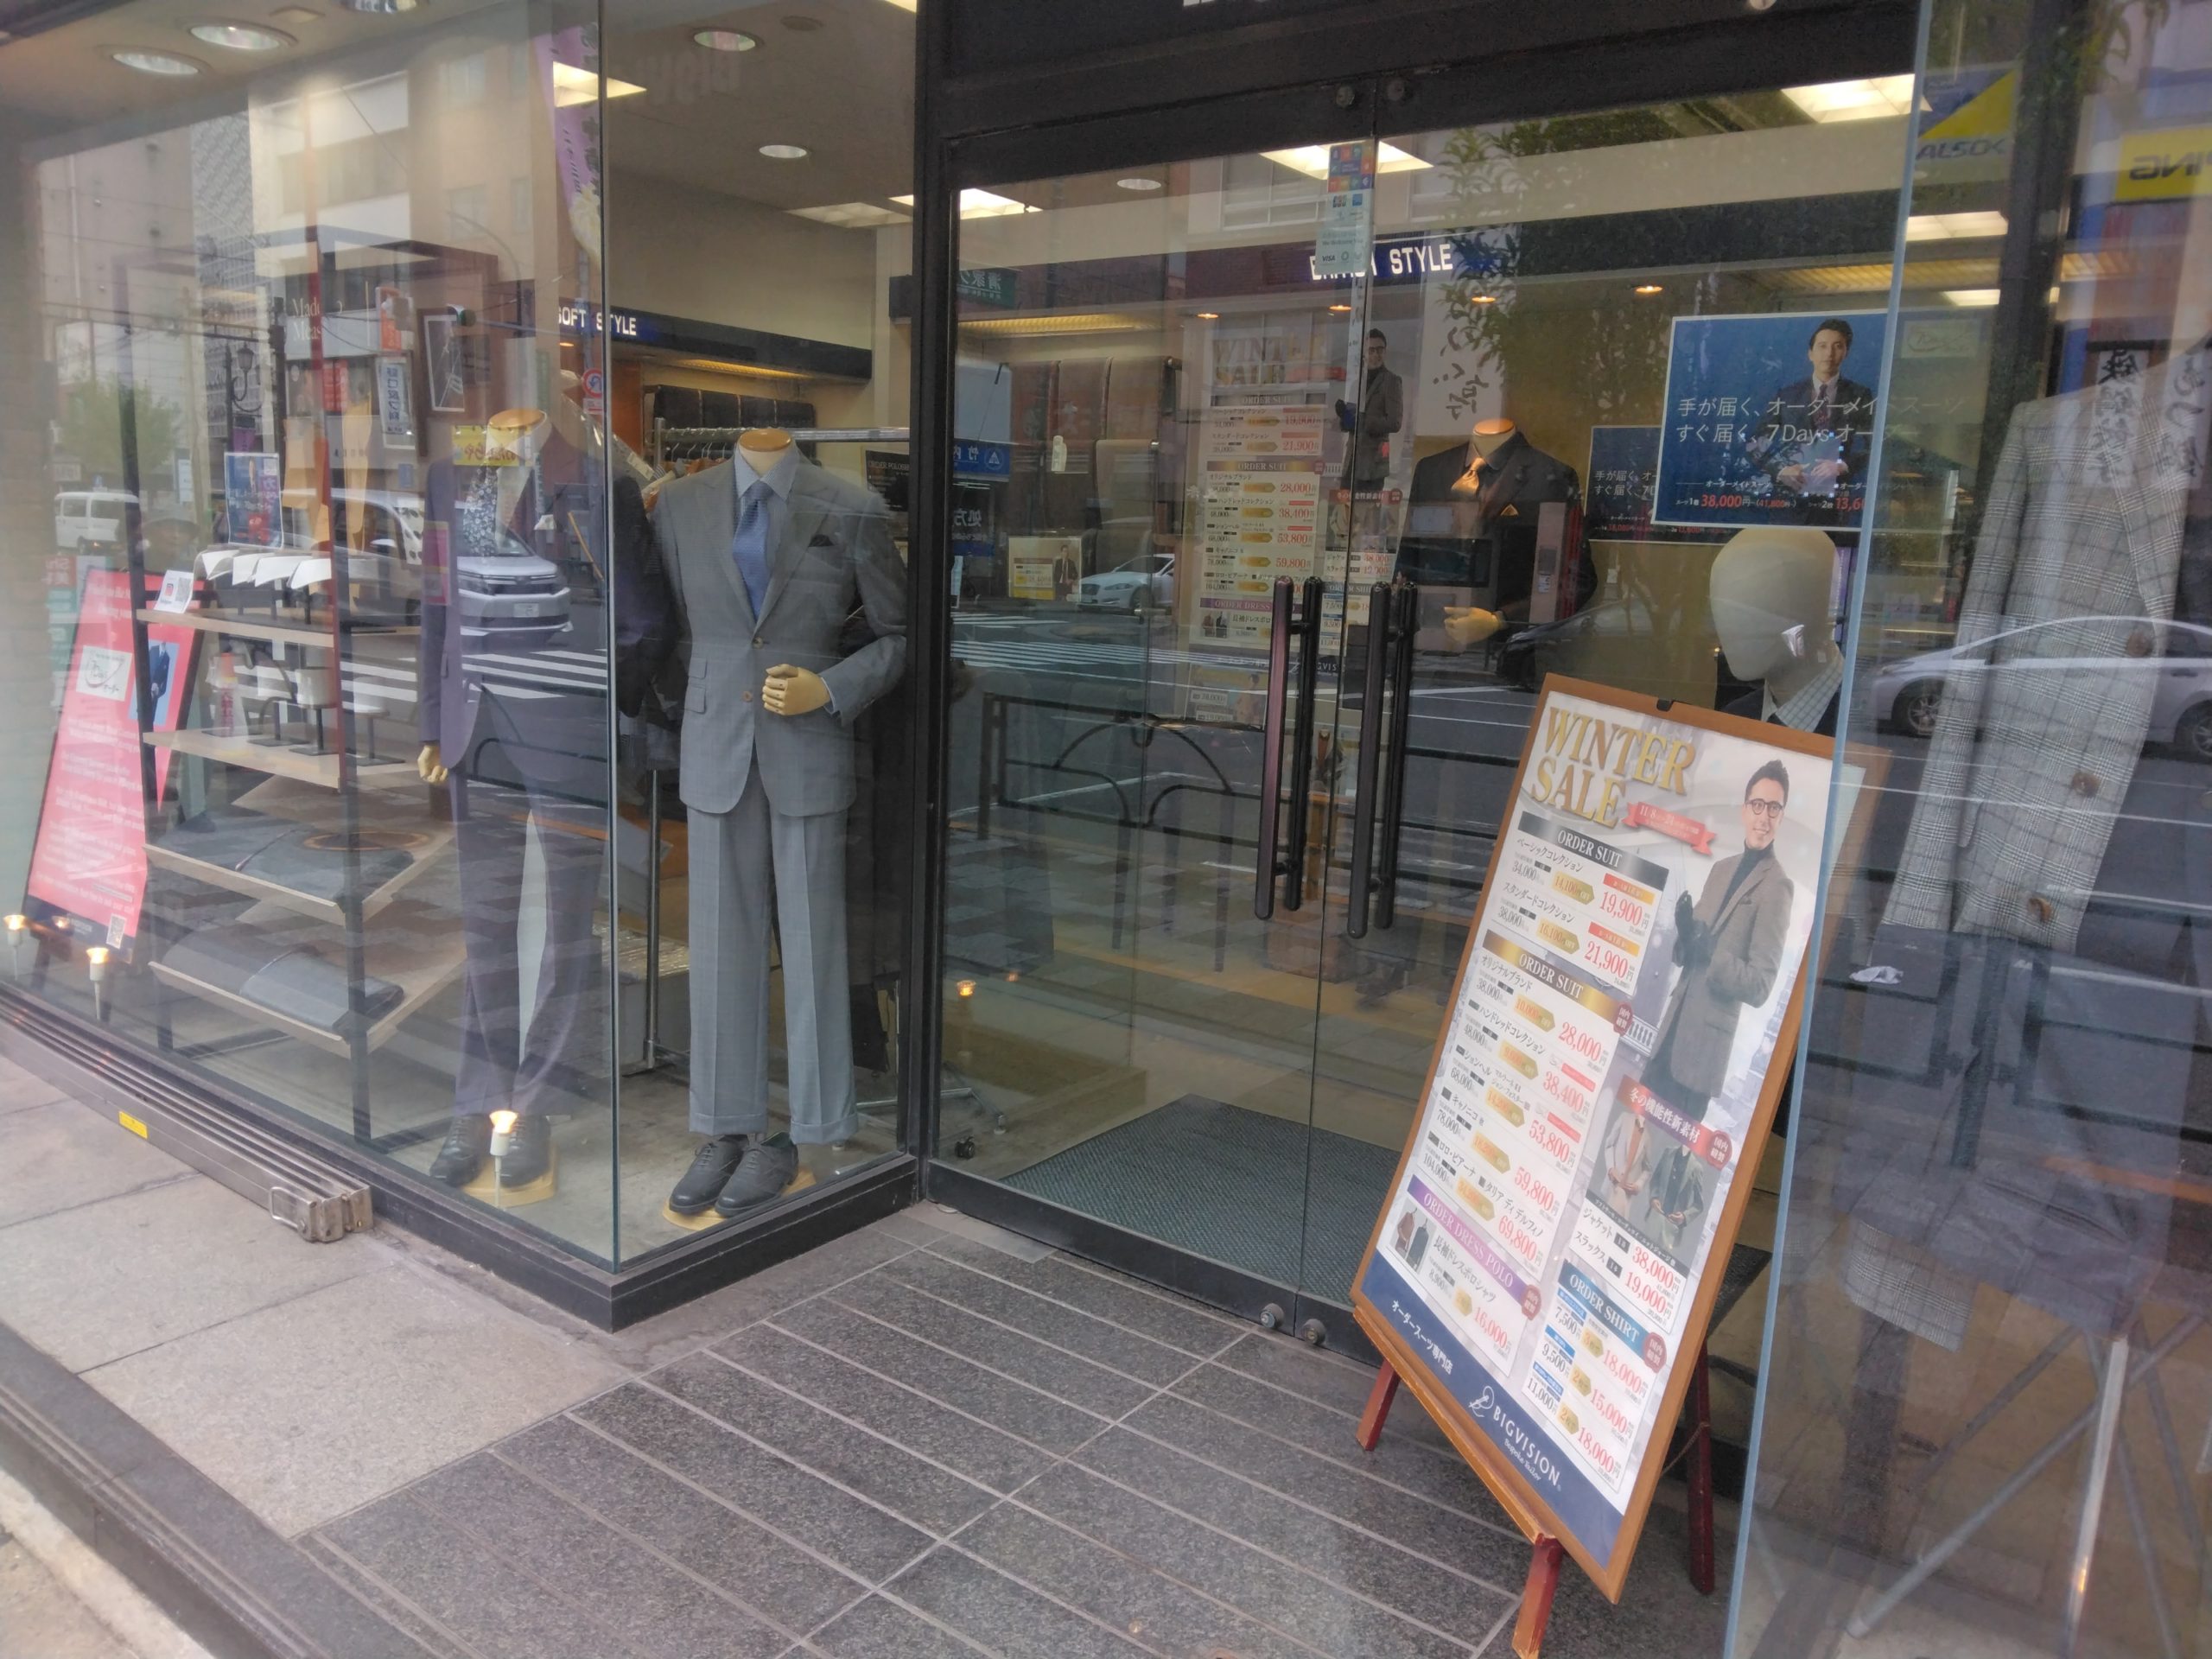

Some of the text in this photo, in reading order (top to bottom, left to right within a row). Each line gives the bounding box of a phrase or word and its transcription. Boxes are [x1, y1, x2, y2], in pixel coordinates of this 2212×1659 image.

[1916, 138, 2005, 161] ALSOK
[1389, 244, 1453, 275] STYLE
[1238, 462, 1268, 471] ORDER
[1215, 600, 1243, 608] ORDER
[1553, 706, 1705, 796] WINTER
[1540, 755, 1626, 830] SALE
[1515, 837, 1584, 874] ベーシックコレクション
[1556, 830, 1622, 868] ORDER SUIT
[1502, 881, 1575, 925] スタンダードコレクション
[1479, 954, 1533, 993] オリジナルブランド
[1517, 952, 1583, 1000] ORDER SUIT
[1477, 1005, 1547, 1057] ハンドレッドコレクション
[1630, 1087, 1700, 1143] 冬の機能性新素材
[1437, 1140, 1477, 1180] ロロ・ピアーナ
[1422, 1192, 1514, 1289] ORDER DRESS POLO
[1581, 1206, 1613, 1241] ジャケット
[1574, 1230, 1606, 1263] スラックス
[1568, 1272, 1640, 1345] ORDER SHIRT
[1391, 1300, 1453, 1375] オーダースーツ専門店
[1493, 1406, 1561, 1485] BIGVISION
[1504, 1438, 1525, 1464] Bespoke
